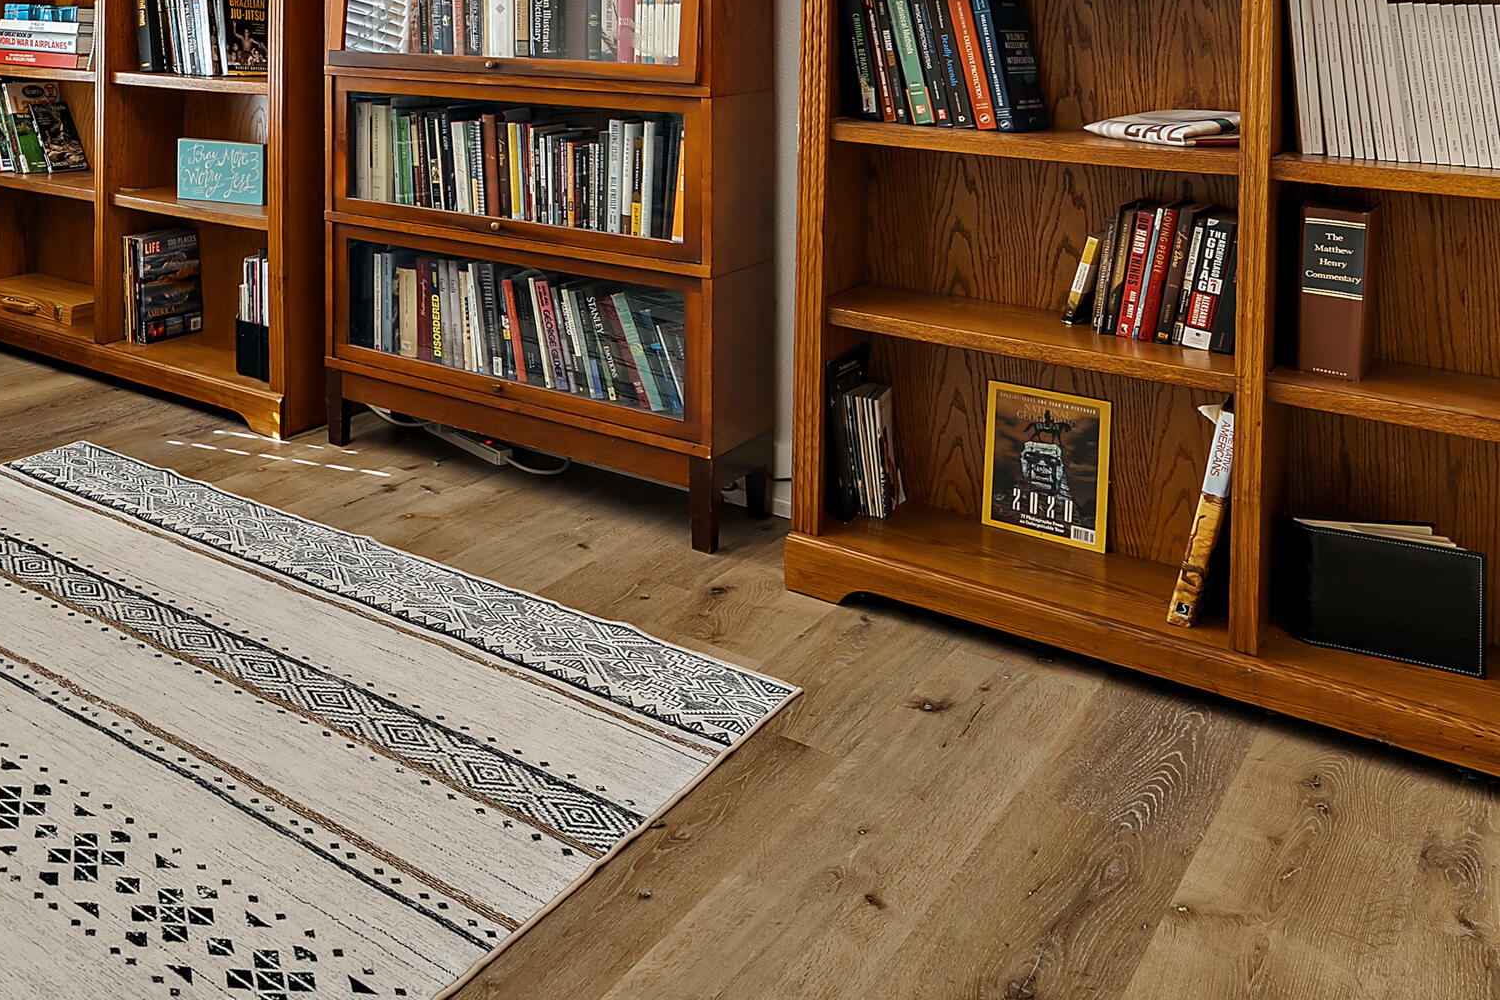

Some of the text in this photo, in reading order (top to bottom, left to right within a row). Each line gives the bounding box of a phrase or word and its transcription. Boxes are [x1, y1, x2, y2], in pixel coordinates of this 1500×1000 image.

[230, 8, 265, 21] JIU-JITSU
[852, 13, 864, 46] CRIMINAL
[895, 0, 914, 54] Statistical Methods
[543, 10, 551, 53] Illustrated
[940, 34, 958, 87] Deadly Arsenals
[145, 241, 160, 255] LIFE
[1133, 230, 1147, 254] HARD
[1154, 211, 1173, 273] LOVING PEOPLE
[1209, 230, 1227, 240] THE
[1315, 244, 1354, 255] Matthew
[1325, 233, 1343, 242] The
[1305, 270, 1361, 285] Commentary
[1319, 258, 1347, 269] Henry
[431, 294, 442, 357] DISORDERED
[542, 310, 556, 346] GEORGE
[587, 296, 604, 335] STANLEY
[1210, 421, 1231, 476] AMERICANS
